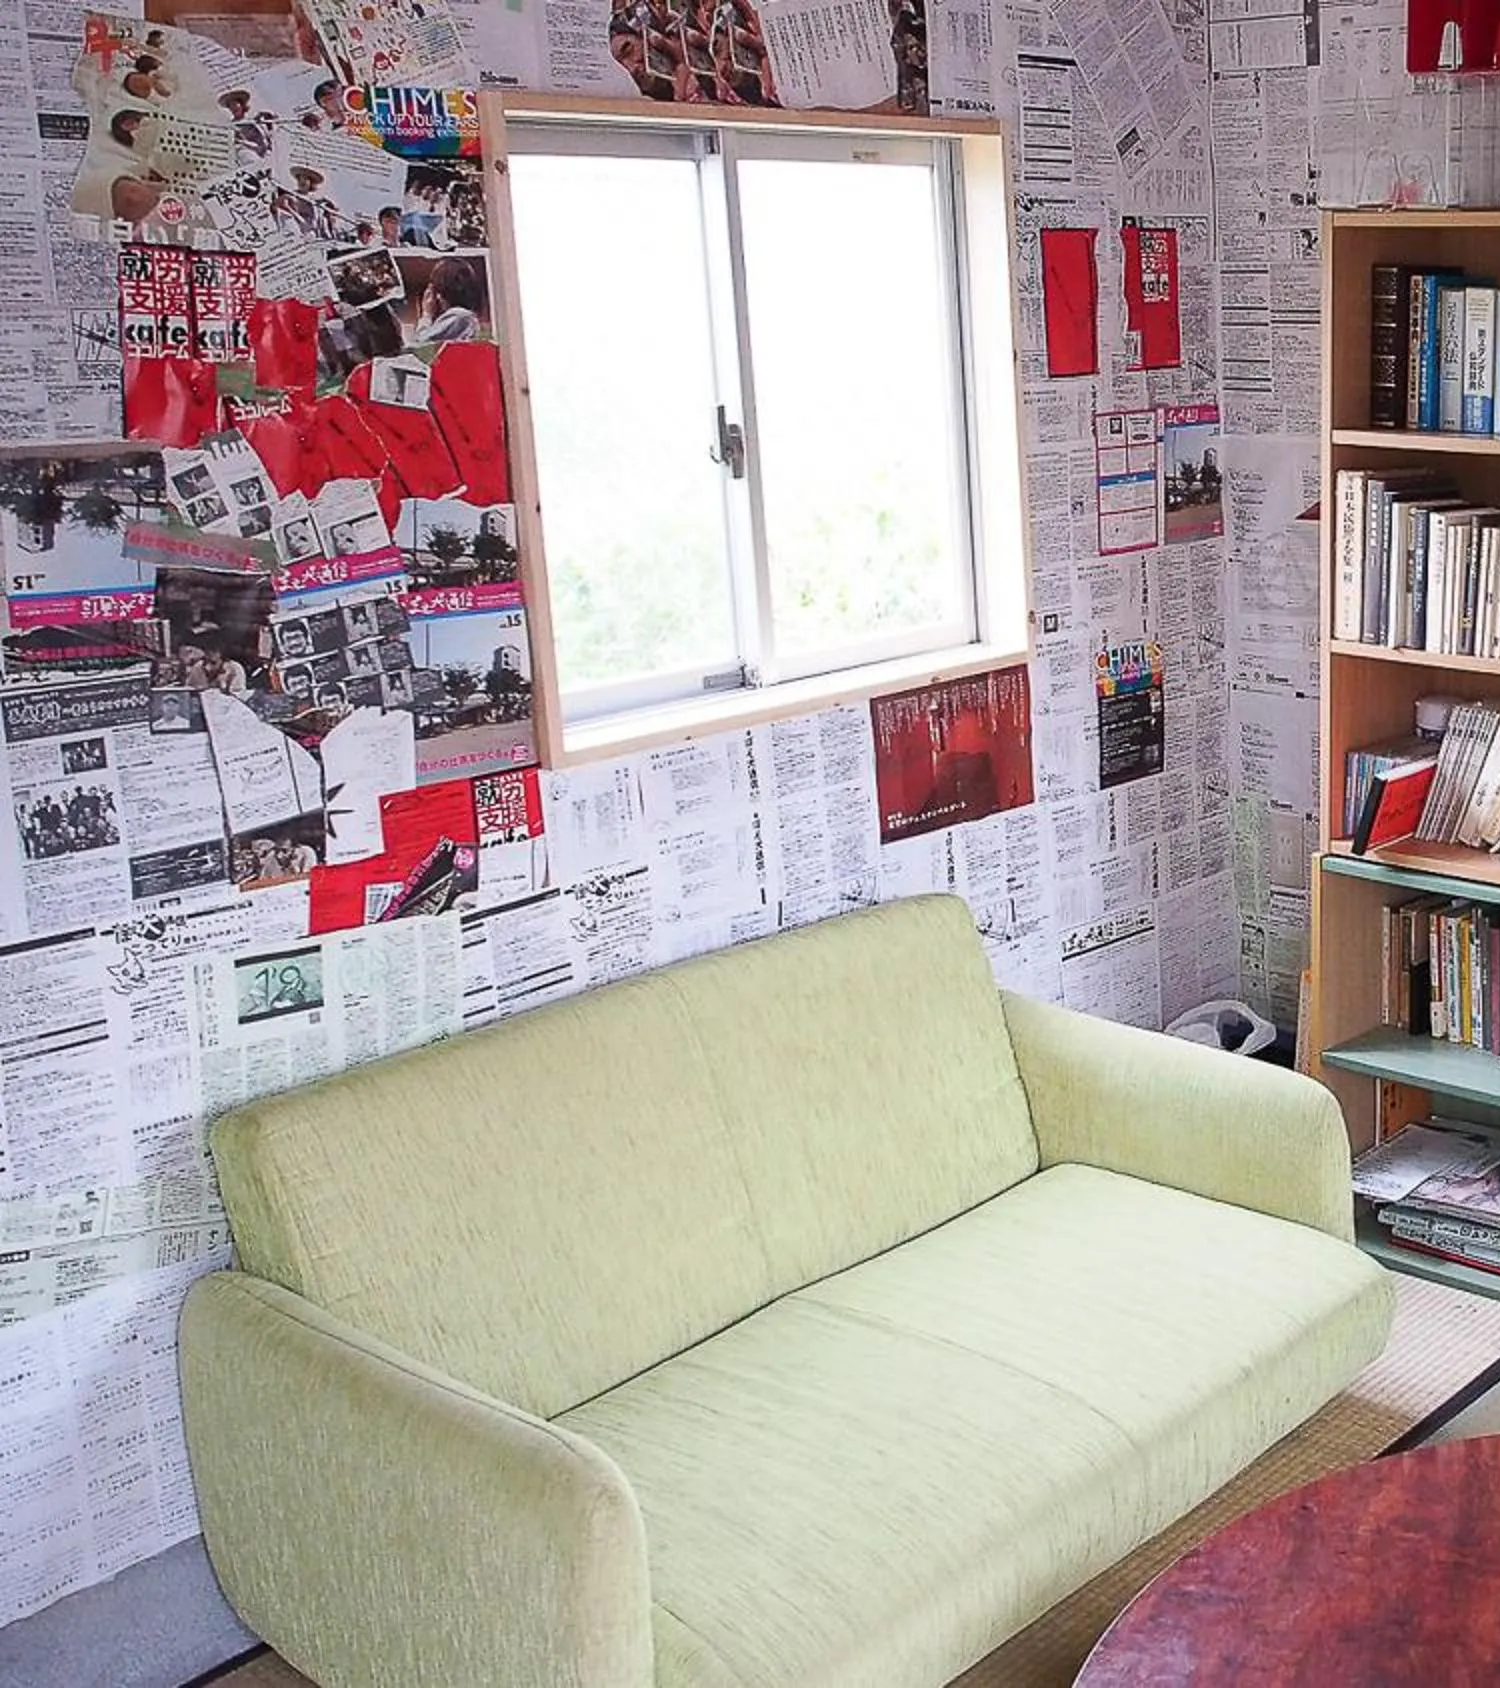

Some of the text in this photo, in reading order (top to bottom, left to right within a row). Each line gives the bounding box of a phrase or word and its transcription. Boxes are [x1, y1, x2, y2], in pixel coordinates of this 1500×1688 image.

[343, 86, 477, 116] CHIMES
[344, 112, 385, 127] PRICK
[388, 113, 405, 127] UP
[123, 252, 187, 283] 就労
[194, 256, 251, 287] 就労
[124, 282, 188, 314] 支援
